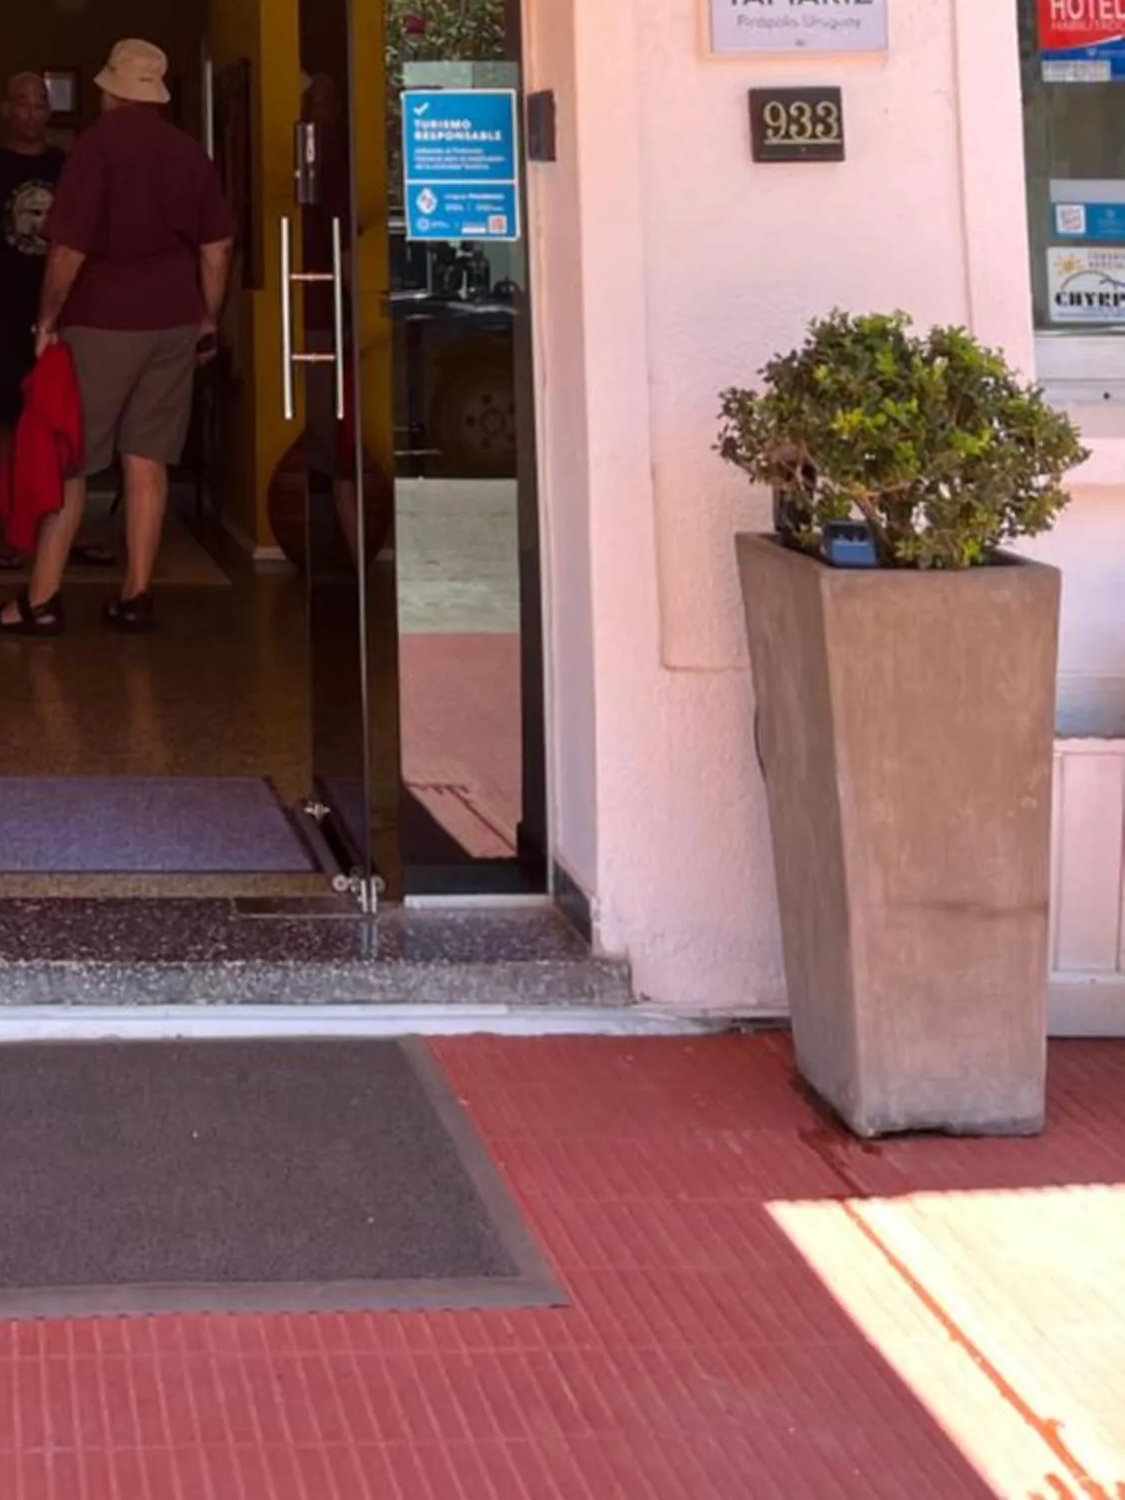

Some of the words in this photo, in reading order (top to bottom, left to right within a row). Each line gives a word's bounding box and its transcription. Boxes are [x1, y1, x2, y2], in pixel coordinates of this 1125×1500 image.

[413, 119, 472, 130] TURISMO
[763, 101, 838, 141] 933
[413, 130, 502, 141] RESPONSABLE
